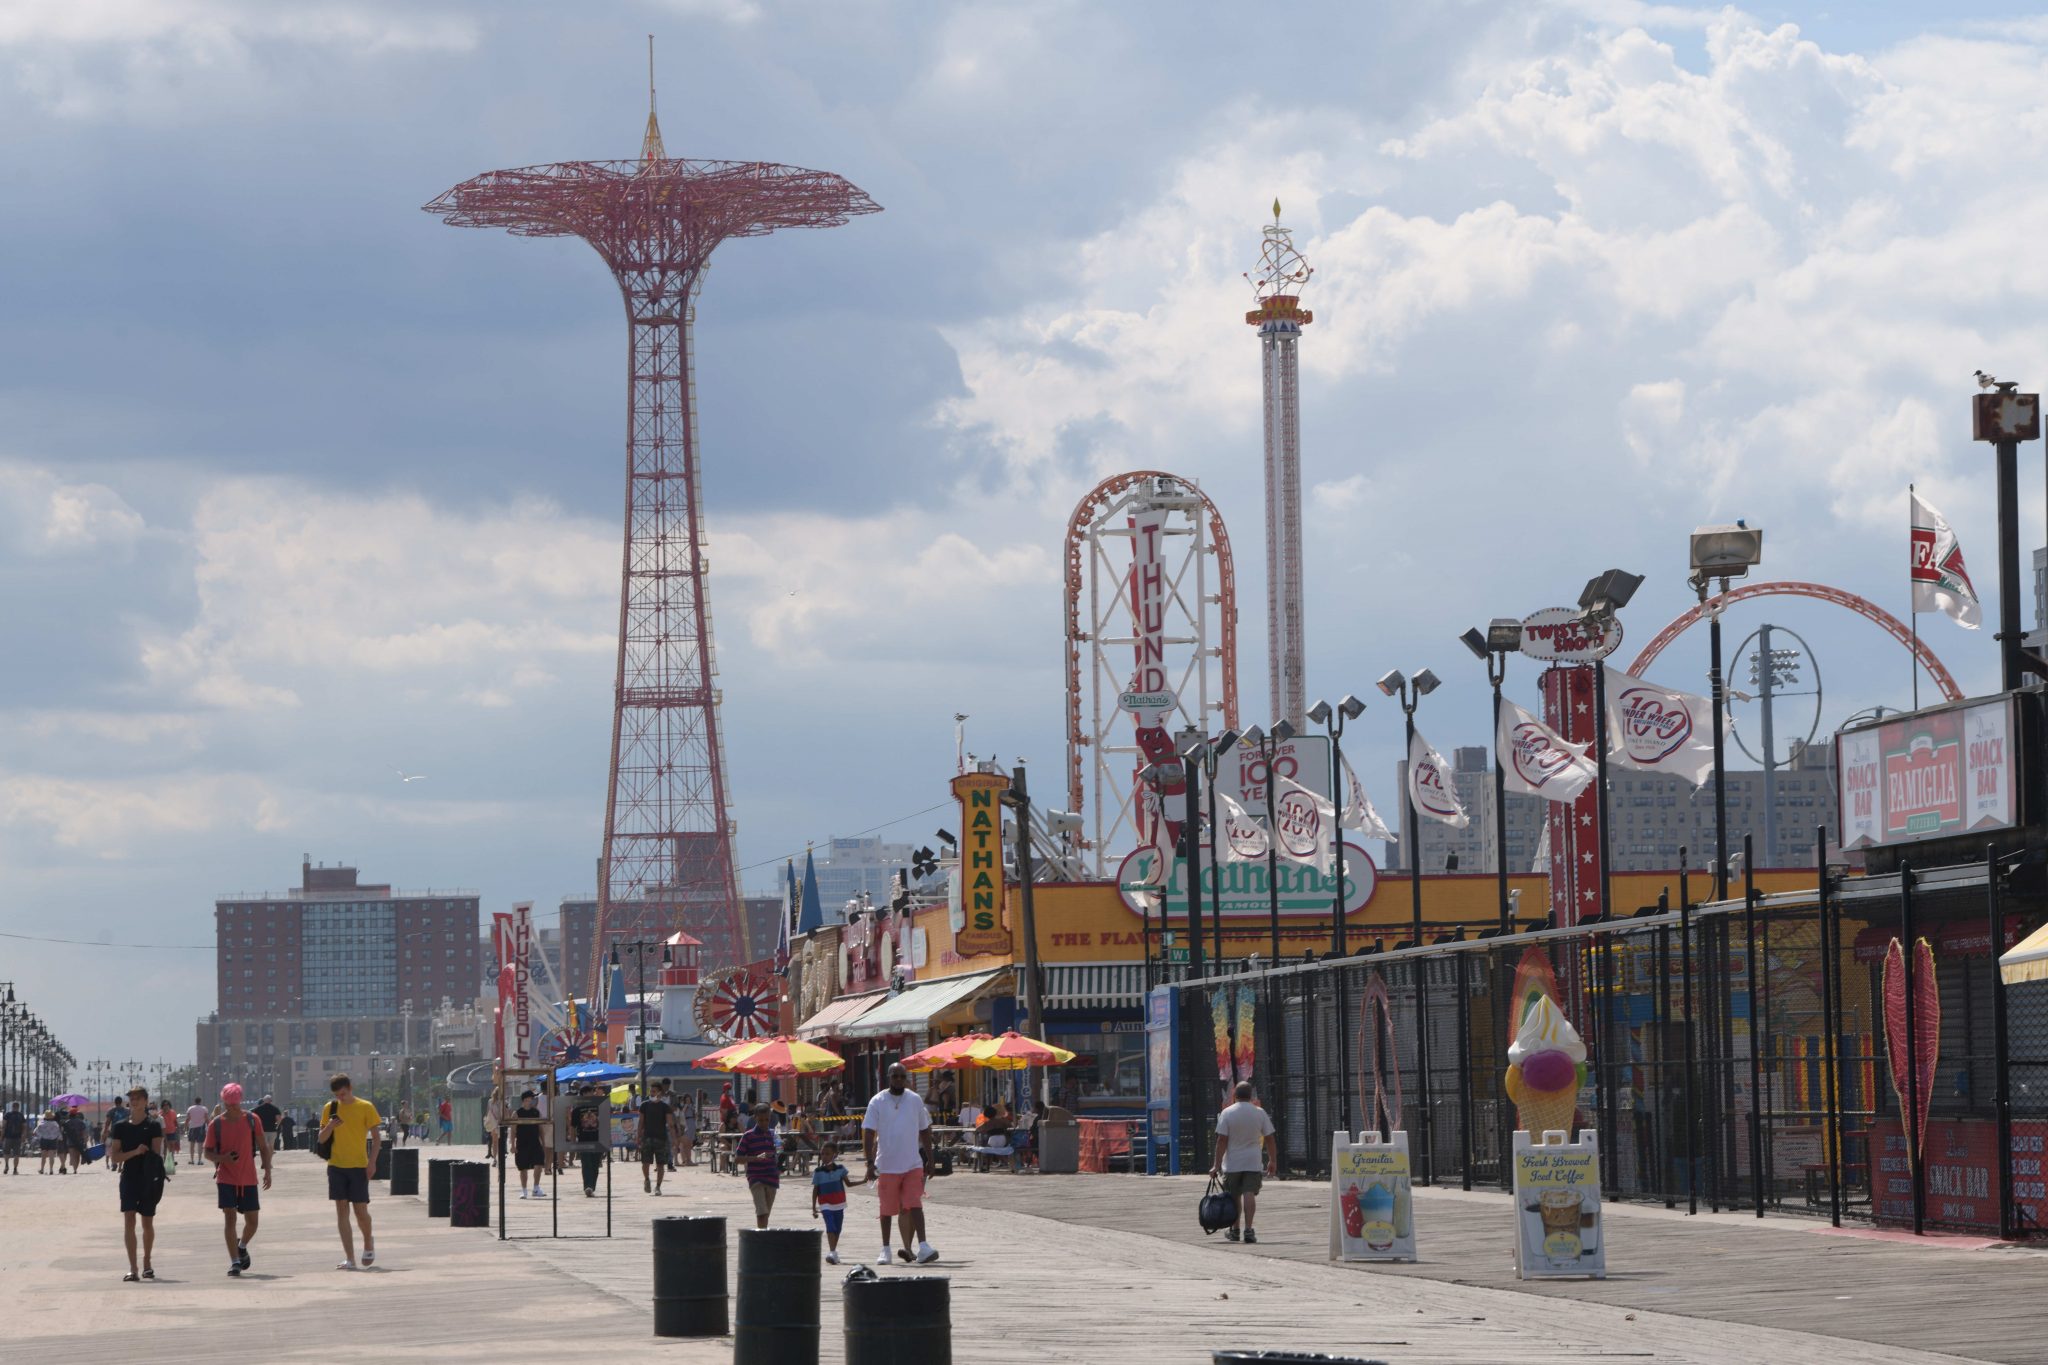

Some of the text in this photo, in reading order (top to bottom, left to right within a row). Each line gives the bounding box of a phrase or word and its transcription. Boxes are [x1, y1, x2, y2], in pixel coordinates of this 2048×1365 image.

[1525, 623, 1579, 641] TWIST
[1123, 694, 1169, 705] Nathan's
[1626, 696, 1687, 740] 100
[1648, 713, 1676, 727] WHEEL
[1240, 749, 1263, 761] FOR
[1969, 737, 2004, 769] SNACK
[1240, 756, 1298, 787] 100
[1847, 762, 1877, 791] SNACK
[1977, 767, 1997, 796] BAR
[1889, 760, 1957, 813] FAMIGLIA
[972, 789, 995, 930] NATHANS
[1051, 933, 1091, 946] THE
[1101, 932, 1161, 945] FLAVO
[1346, 928, 1395, 940] INCE
[1173, 950, 1184, 961] W
[514, 907, 530, 1069] THUNDERBOLT
[1522, 1155, 1591, 1168] Fresh Brewed
[1530, 1170, 1584, 1184] Iced Coffee
[1929, 1165, 1963, 1196] SNACK
[1966, 1167, 1988, 1198] BAR
